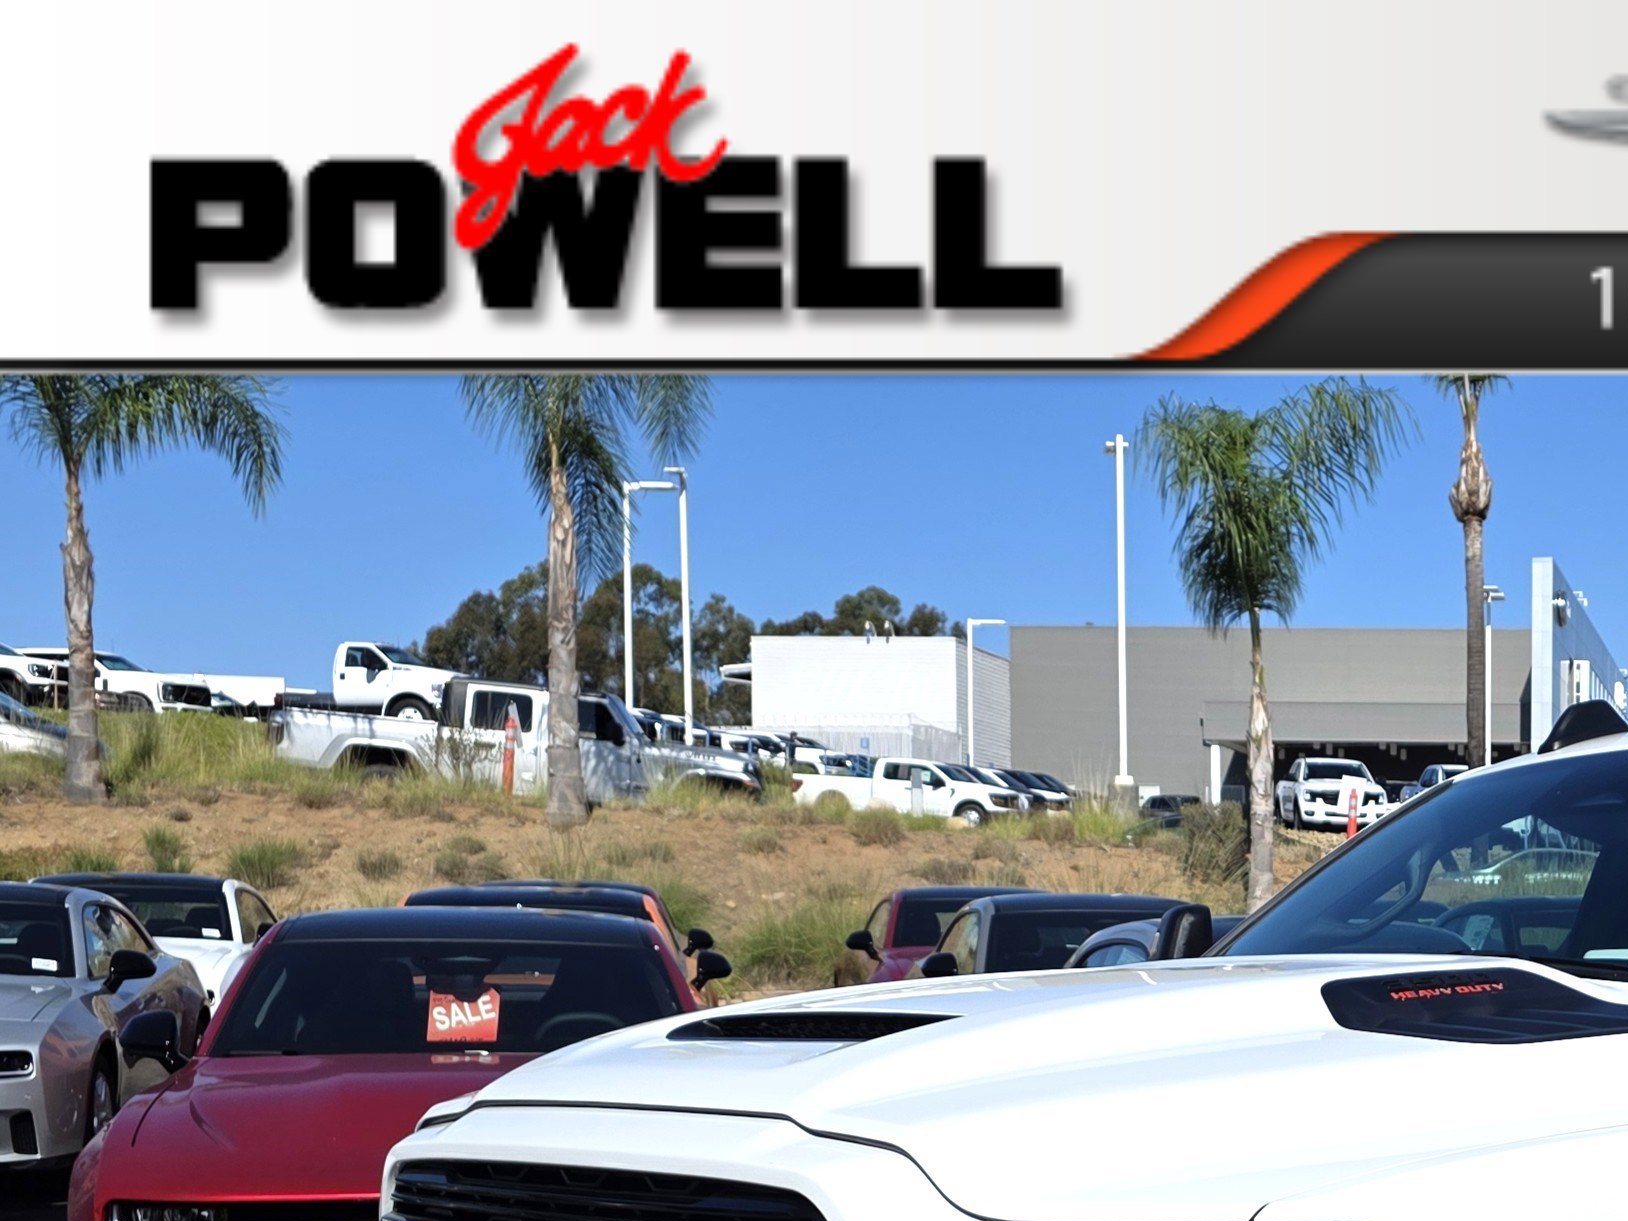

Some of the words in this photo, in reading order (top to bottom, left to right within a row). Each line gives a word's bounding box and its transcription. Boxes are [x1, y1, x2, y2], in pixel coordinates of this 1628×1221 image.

[1389, 986, 1452, 1002] HEAVY
[1454, 982, 1504, 995] DUTY
[432, 994, 497, 1031] SALE
